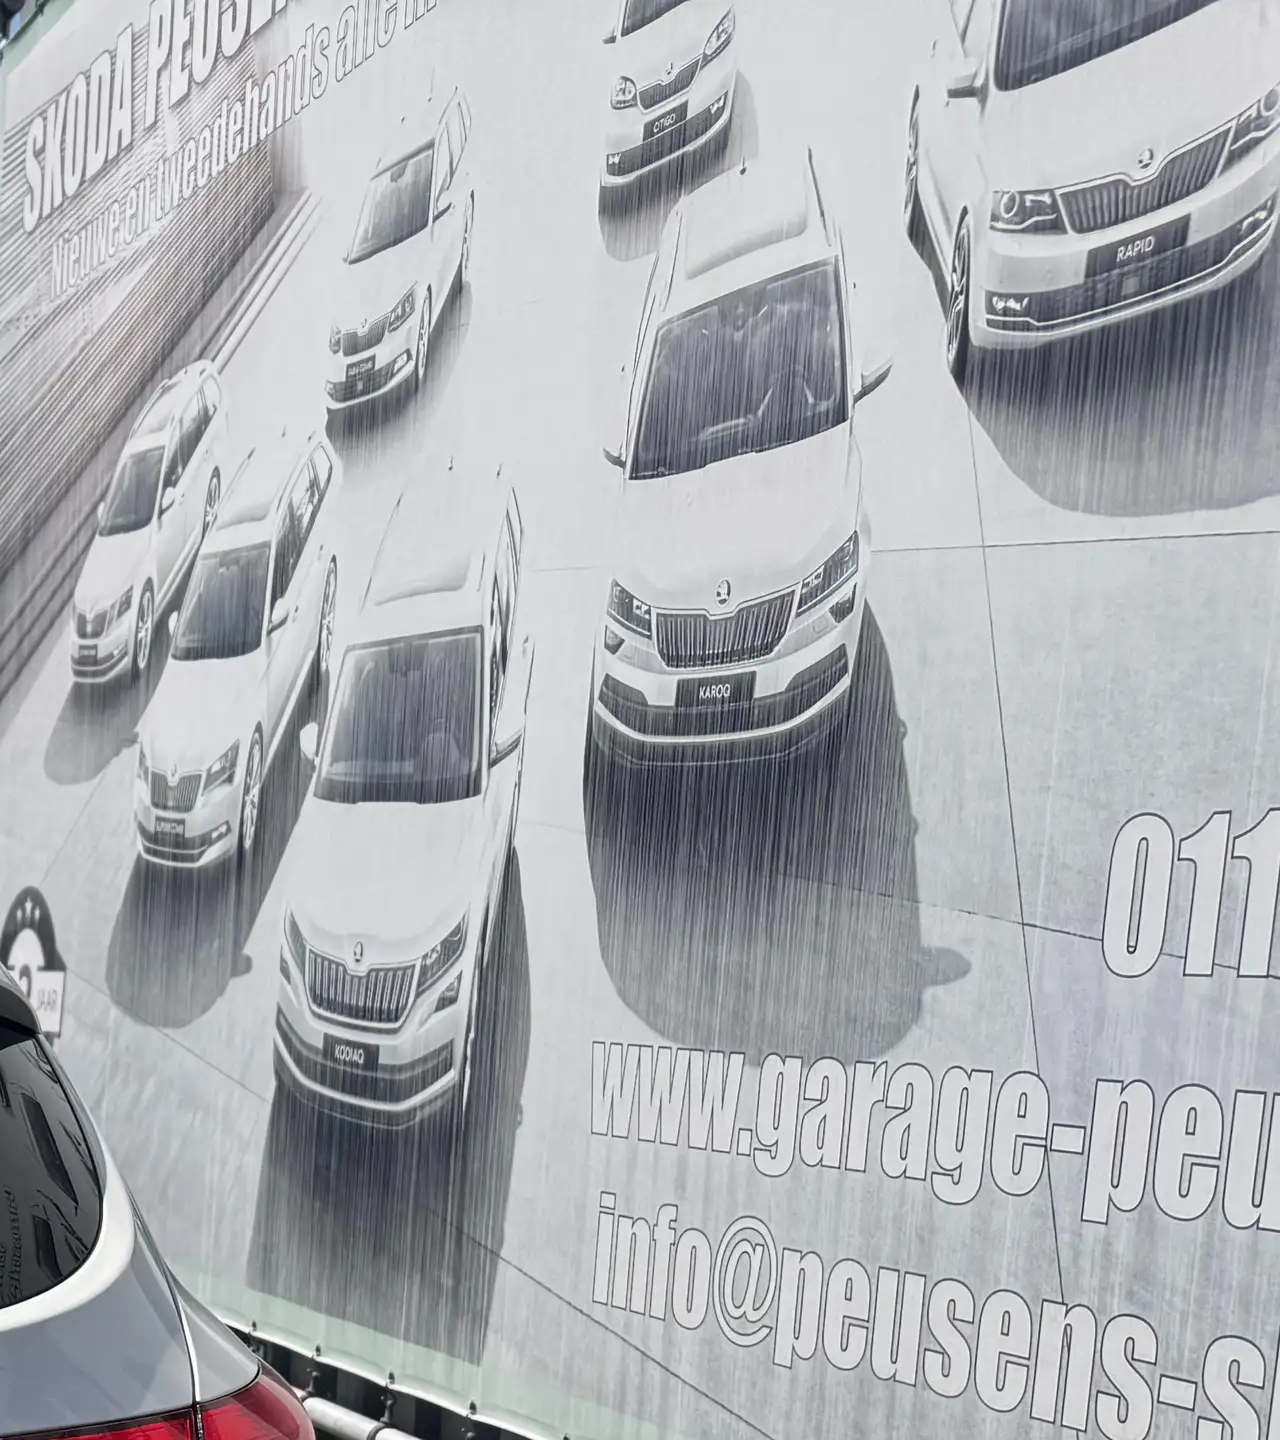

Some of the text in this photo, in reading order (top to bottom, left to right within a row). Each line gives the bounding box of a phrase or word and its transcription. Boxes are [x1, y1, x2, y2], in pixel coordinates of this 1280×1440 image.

[22, 22, 133, 233] SKODA
[51, 199, 121, 299] Nieuwe
[123, 173, 151, 245] en
[155, 23, 330, 221] tweedehands
[1116, 235, 1156, 262] RAPID
[699, 683, 731, 699] KAROQ
[1102, 807, 1280, 978] 011
[334, 1043, 365, 1065] KODIAQ
